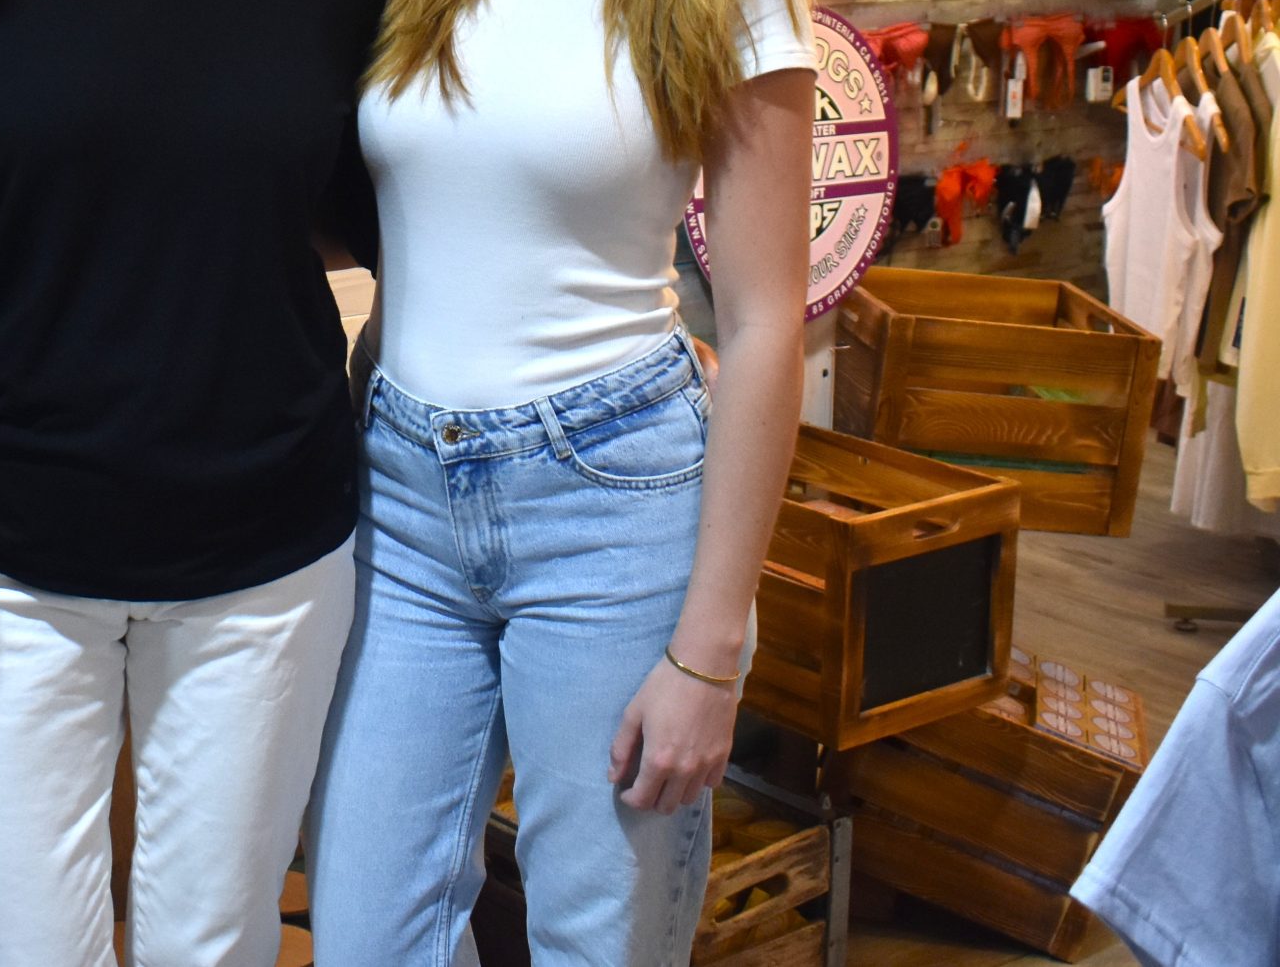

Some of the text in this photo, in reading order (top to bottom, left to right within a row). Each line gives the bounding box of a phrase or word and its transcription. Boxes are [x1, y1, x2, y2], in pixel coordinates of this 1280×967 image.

[812, 10, 856, 43] RPINTERIA
[812, 181, 895, 315] 85 GRAMS NON-TOXIC
[808, 253, 840, 287] OUR
